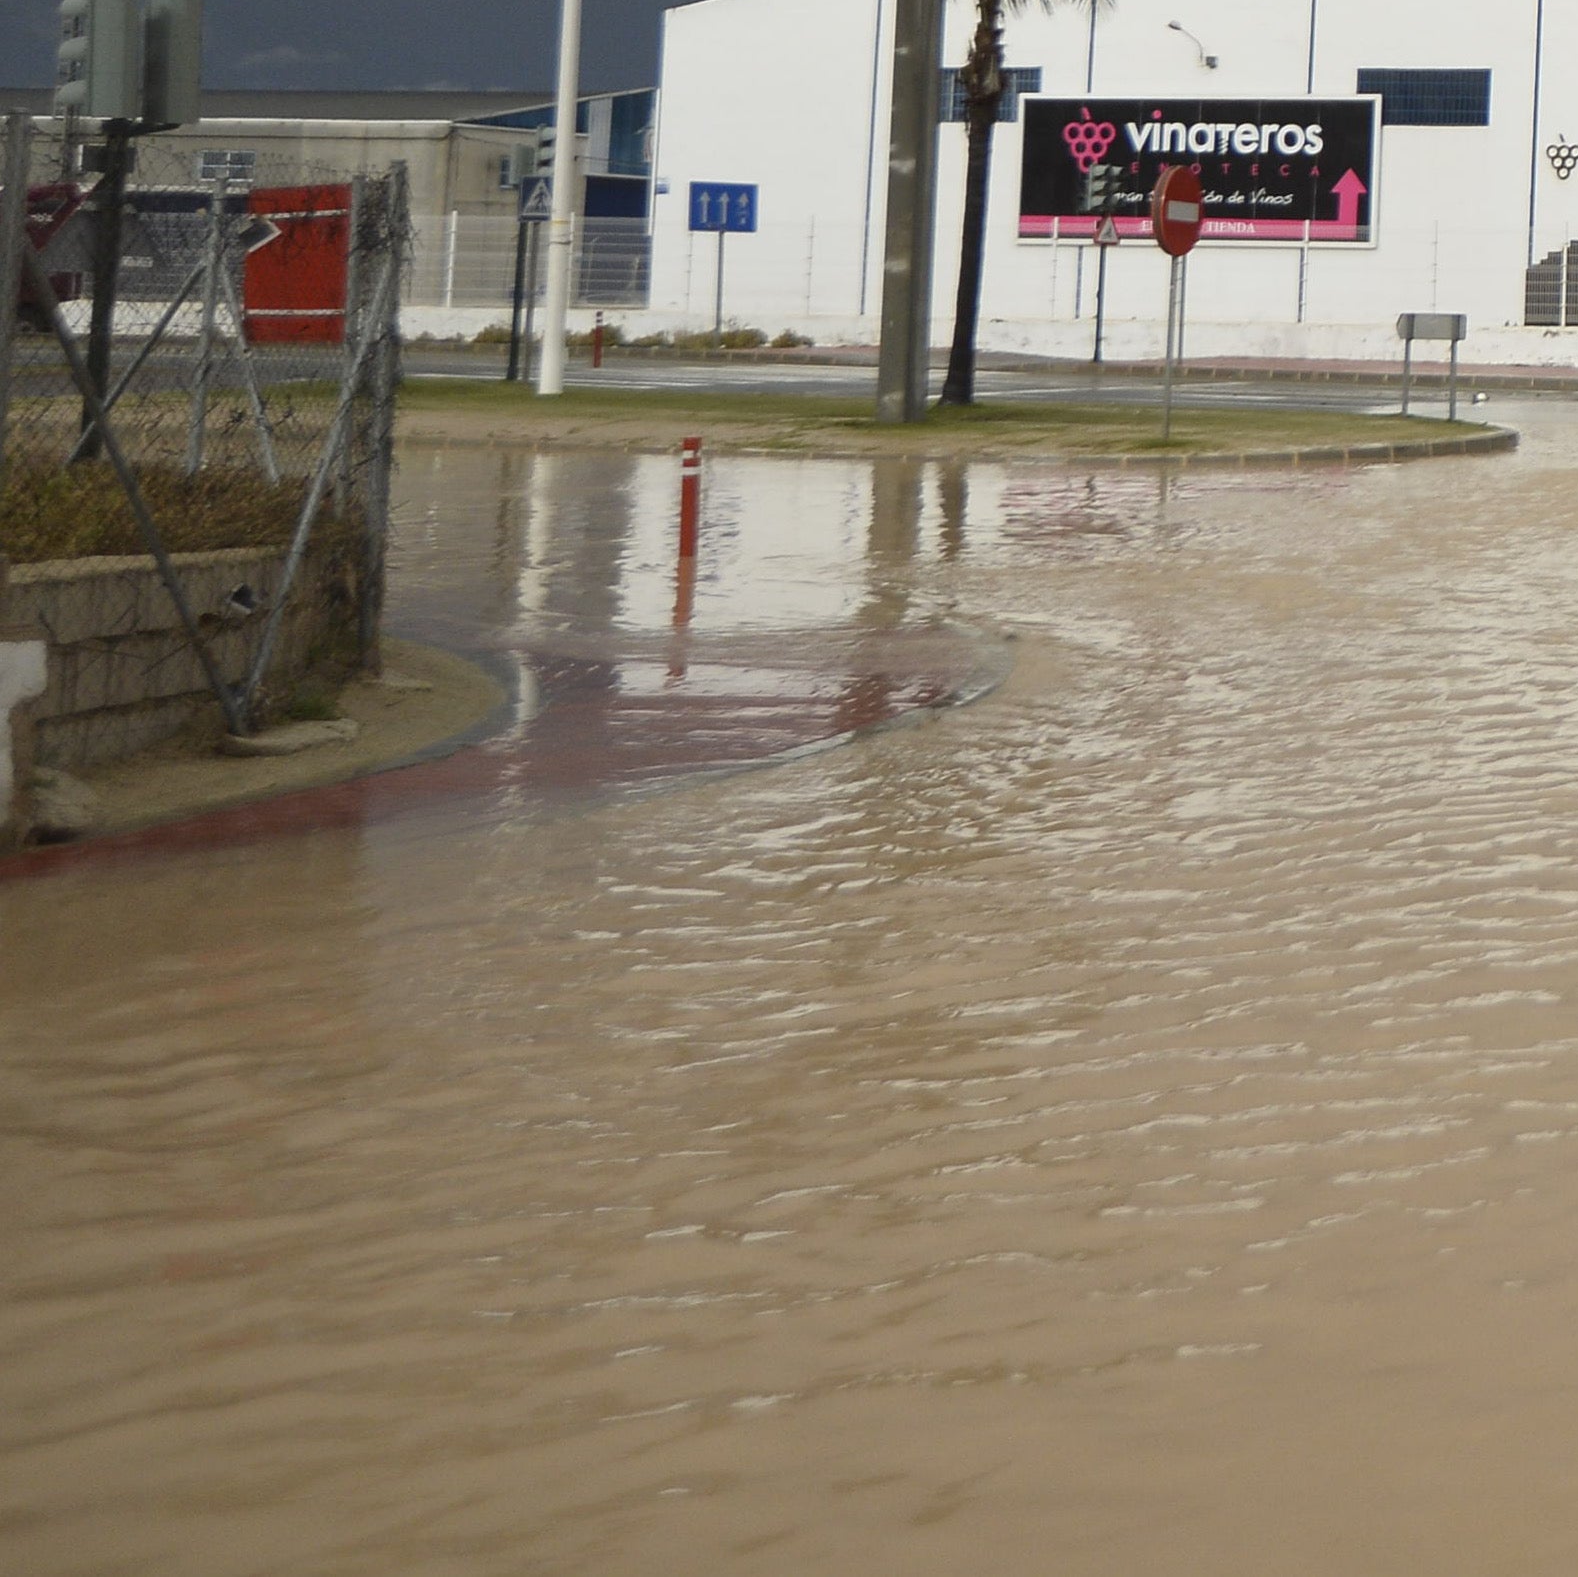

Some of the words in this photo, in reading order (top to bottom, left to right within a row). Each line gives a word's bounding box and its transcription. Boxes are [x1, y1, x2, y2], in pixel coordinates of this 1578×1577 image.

[1124, 109, 1324, 155] vinateros
[1250, 186, 1294, 205] Vinos
[1206, 220, 1256, 234] TIENDA
